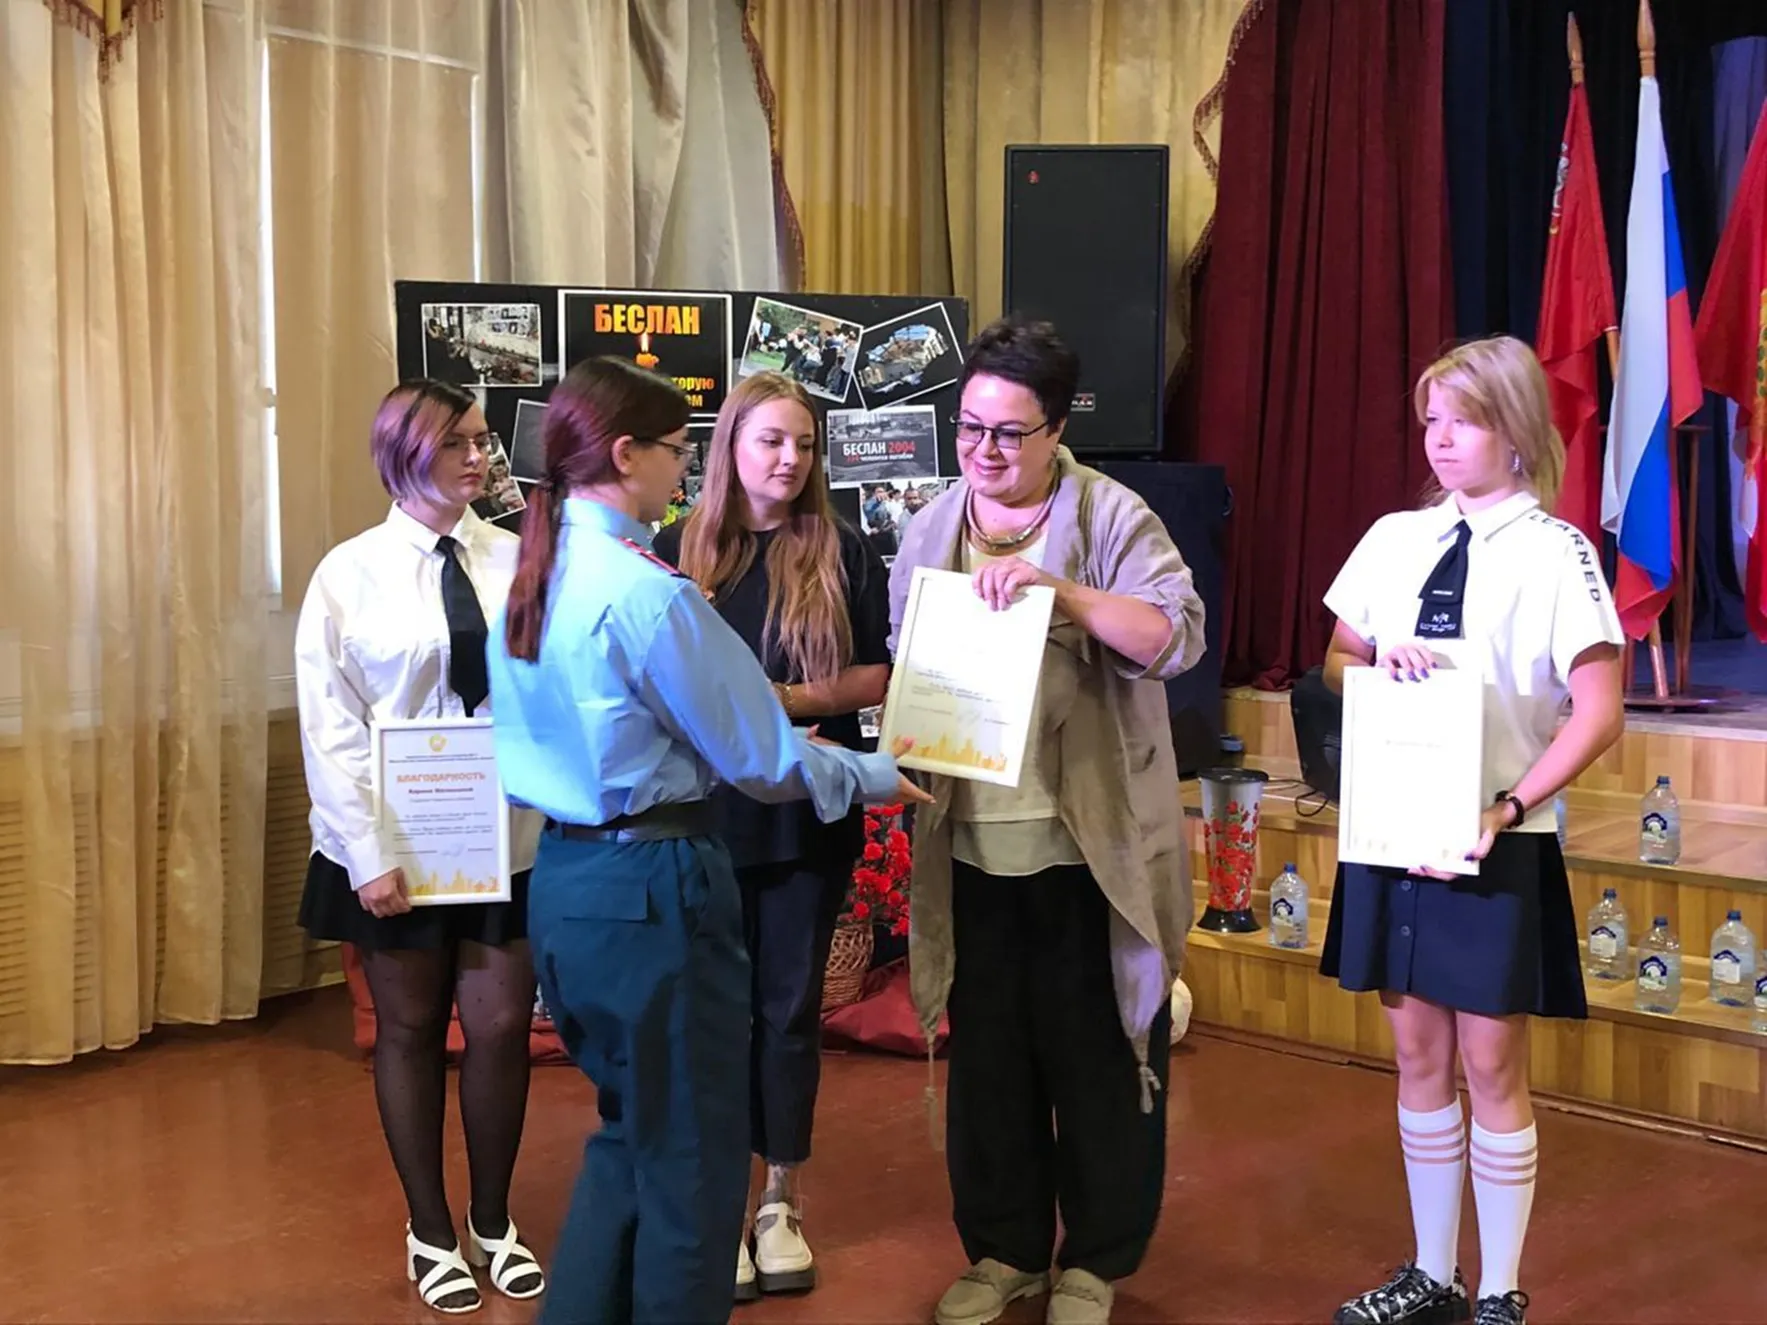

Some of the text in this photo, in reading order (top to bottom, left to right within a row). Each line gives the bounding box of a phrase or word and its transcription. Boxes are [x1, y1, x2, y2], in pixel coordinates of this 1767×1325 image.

[594, 304, 700, 335] БЕСЛАН
[842, 441, 916, 456] БЕСЛАН 2004
[1529, 513, 1601, 602] LEARNED
[396, 771, 486, 783] БЛАГОДАРНОСТЬ
